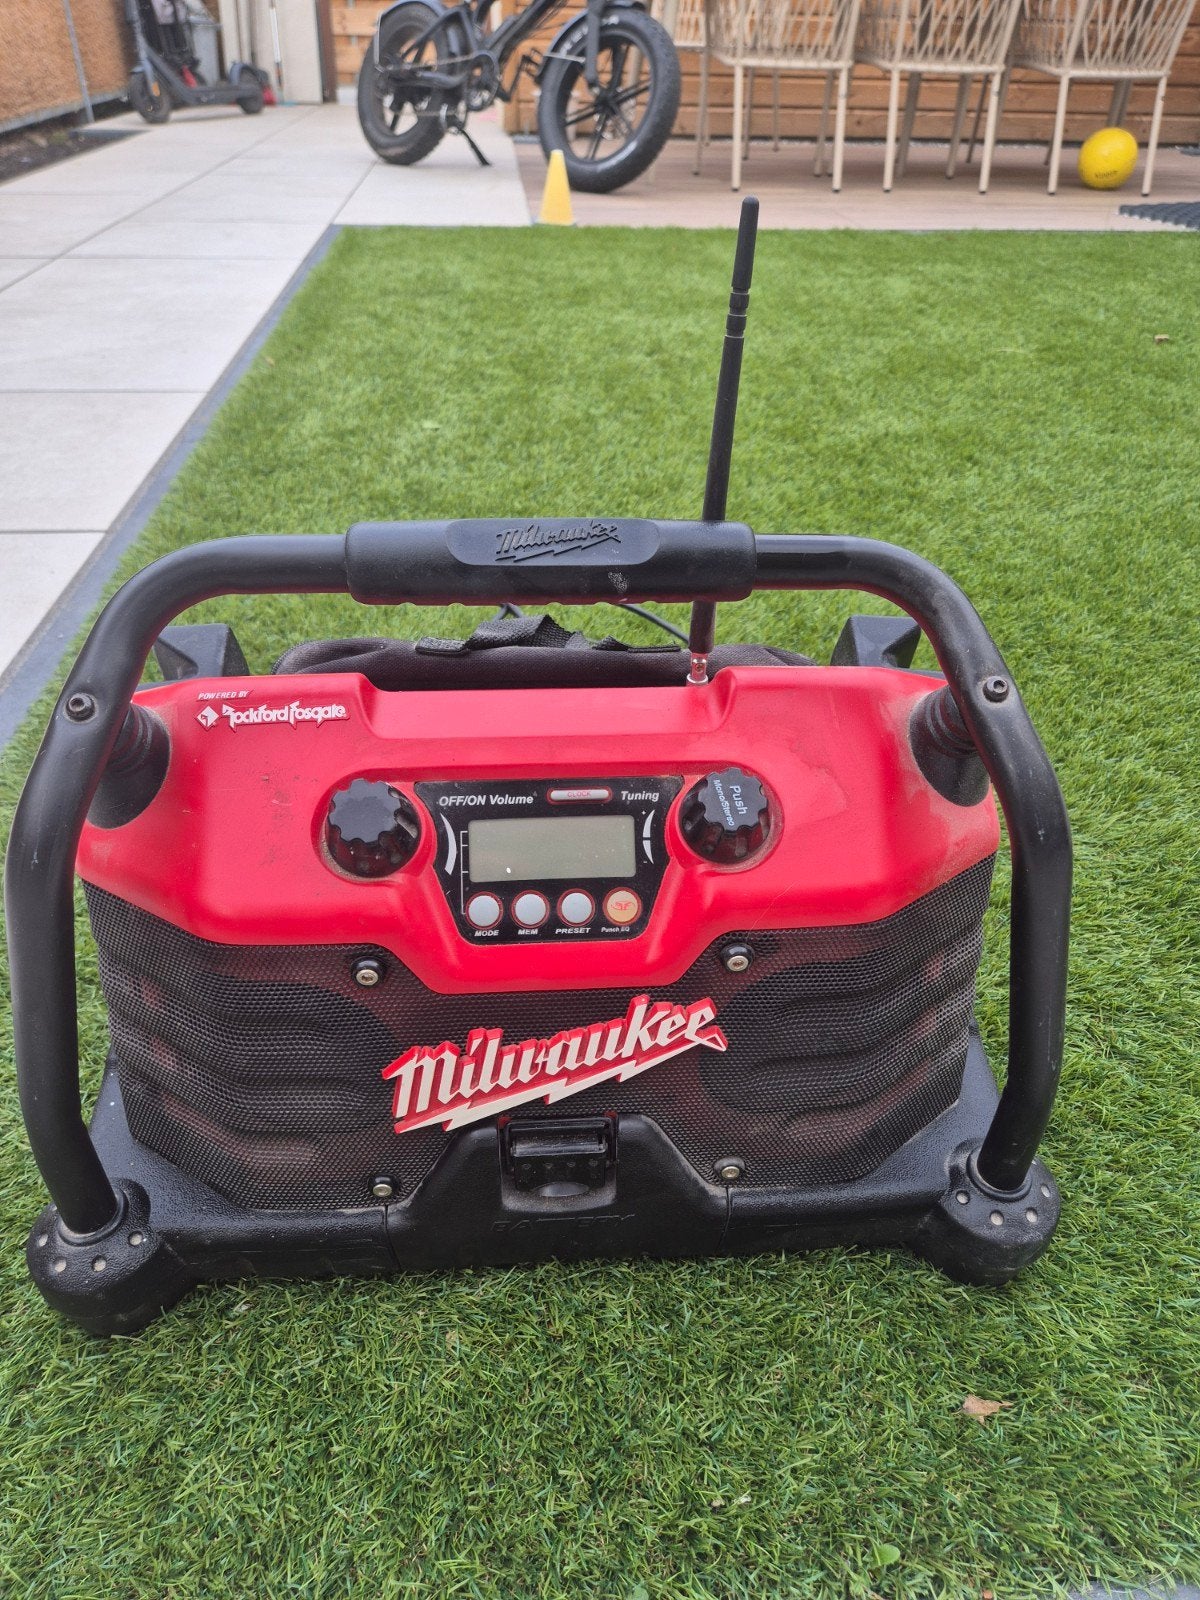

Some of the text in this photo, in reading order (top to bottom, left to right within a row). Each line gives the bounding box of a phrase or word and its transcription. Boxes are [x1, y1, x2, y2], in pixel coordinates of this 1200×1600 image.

[198, 690, 249, 700] POWERED BY
[439, 794, 534, 806] OFF/ON Volume
[621, 790, 660, 802] Tuning
[713, 779, 735, 826] Mono/Stereo
[729, 785, 748, 815] Push
[382, 994, 728, 1132] Milwaukee
